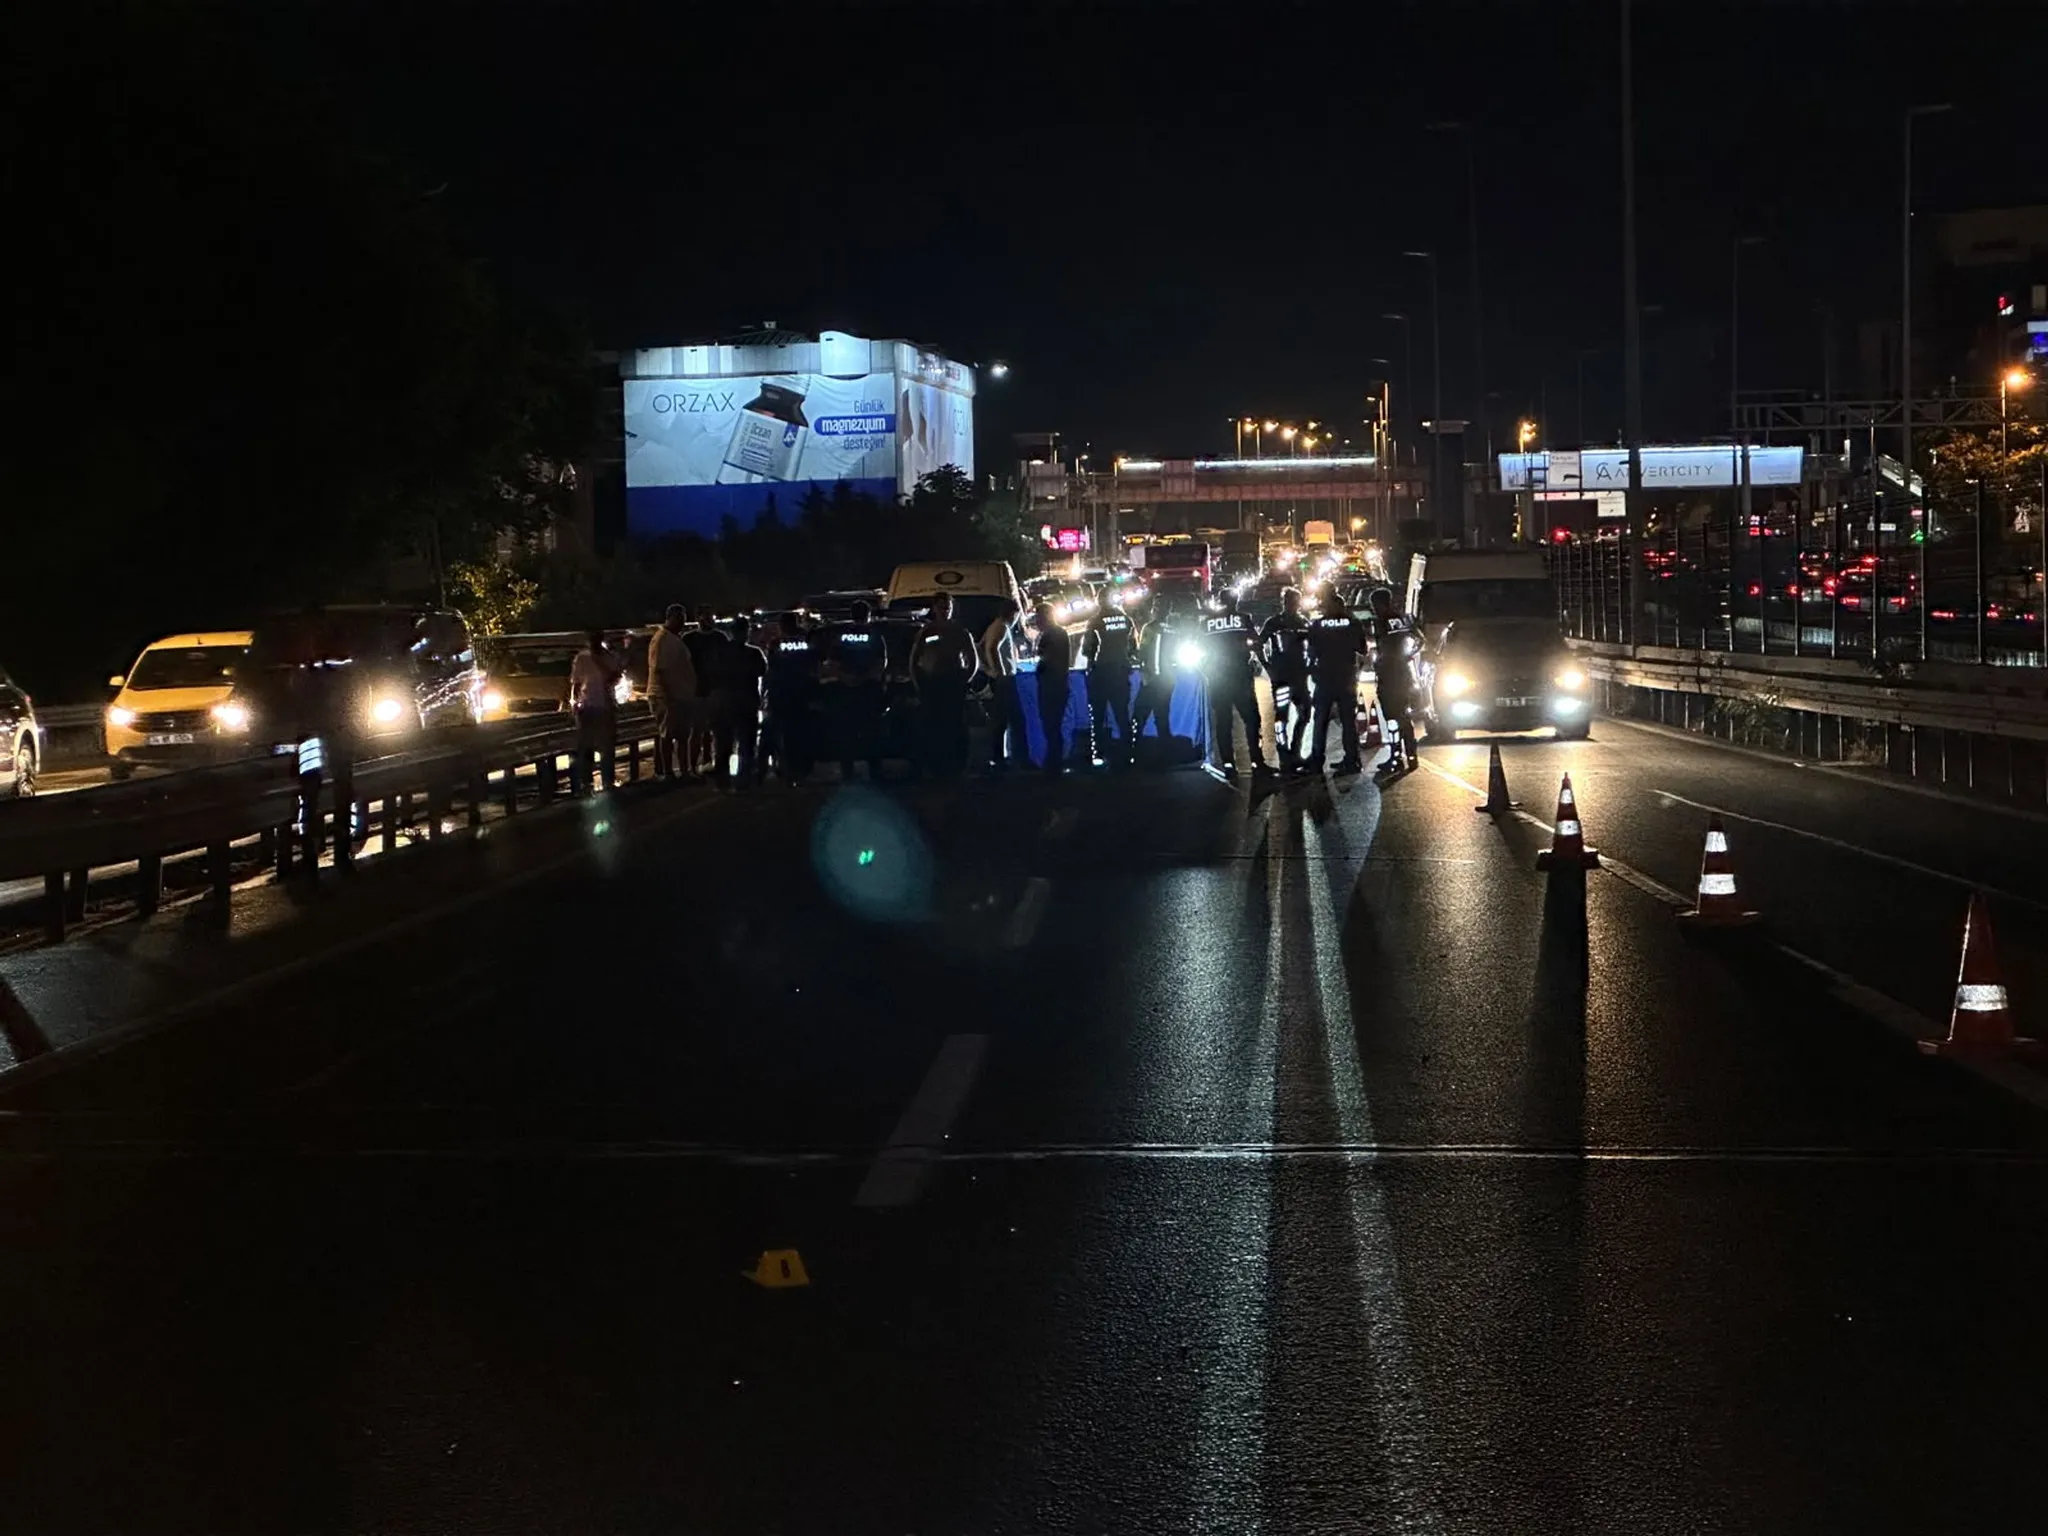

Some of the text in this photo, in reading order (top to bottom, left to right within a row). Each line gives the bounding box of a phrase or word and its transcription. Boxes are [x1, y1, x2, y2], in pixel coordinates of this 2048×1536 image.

[652, 392, 735, 413] ORZAX
[822, 417, 886, 435] magnezyum
[1615, 465, 1714, 478] AVERTCITY
